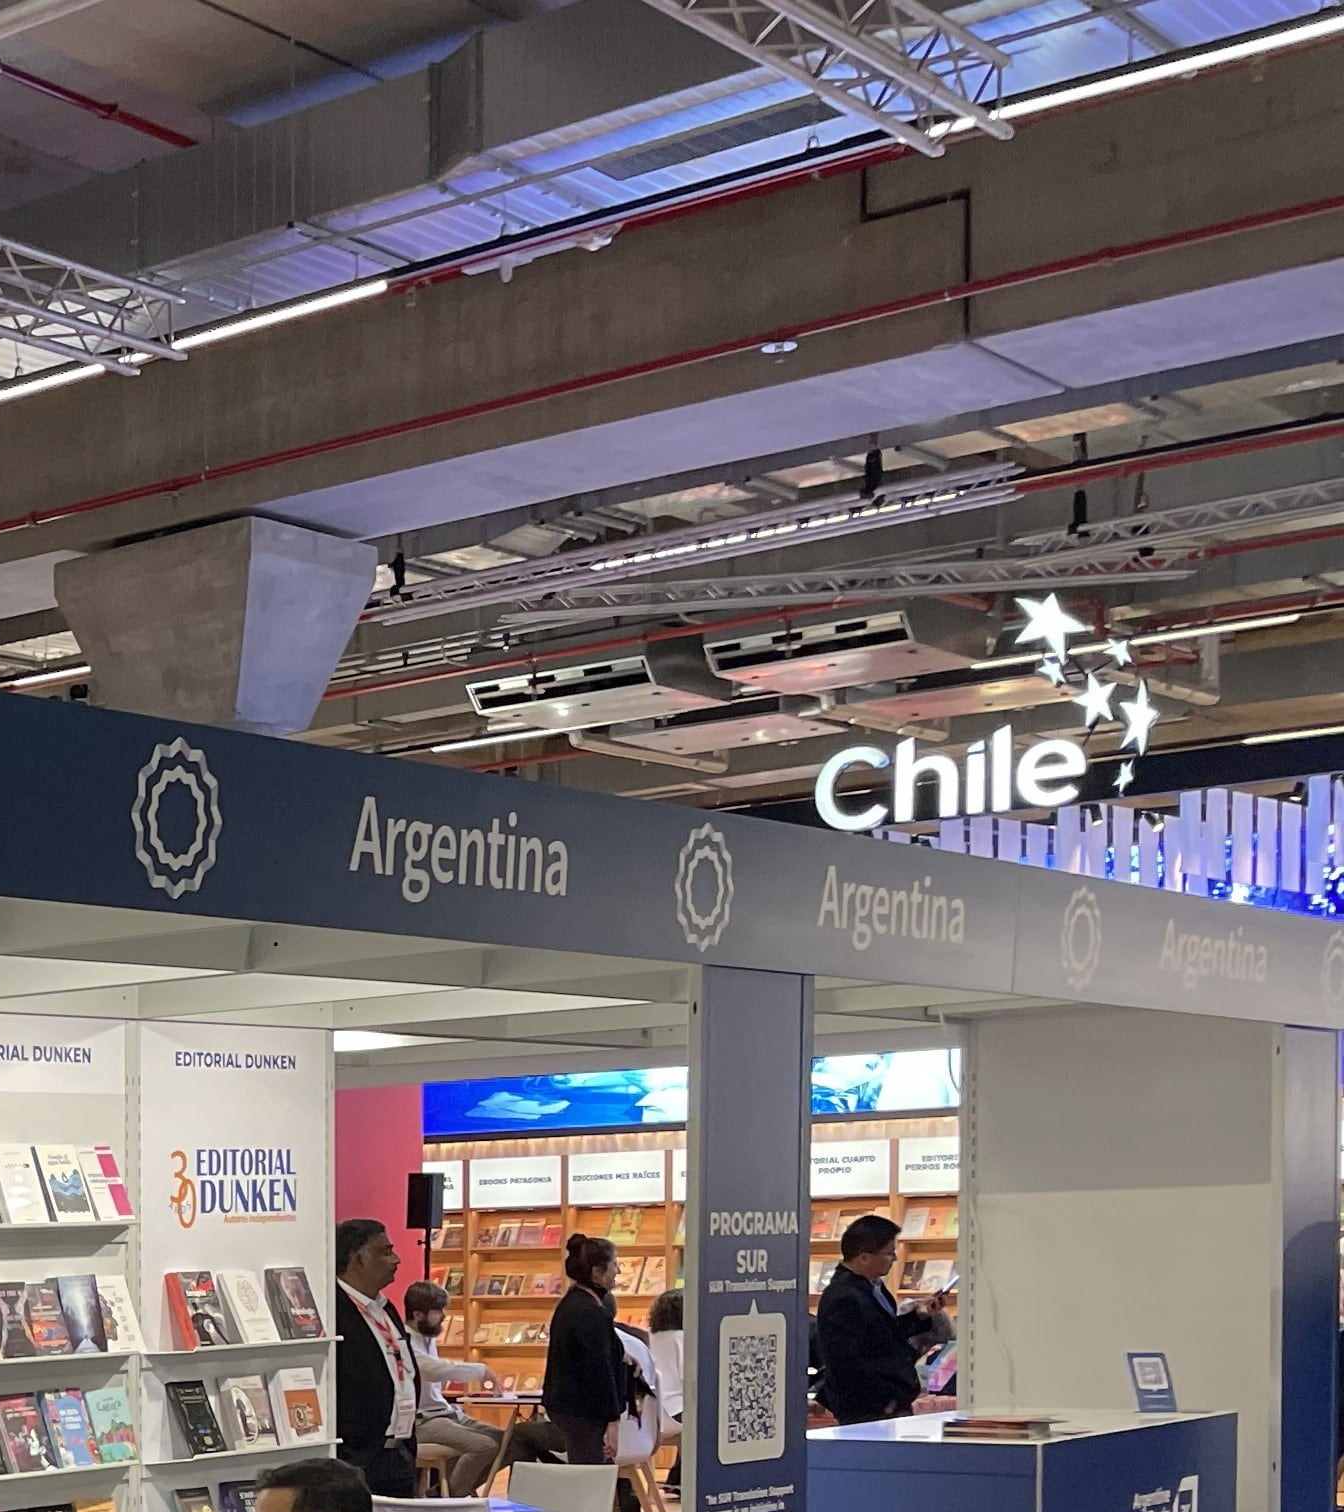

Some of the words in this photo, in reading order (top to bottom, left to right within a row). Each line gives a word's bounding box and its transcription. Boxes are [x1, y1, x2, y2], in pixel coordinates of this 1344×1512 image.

[814, 724, 1087, 832] Chile
[349, 796, 568, 903] Argentina
[818, 865, 965, 951] Argentina
[1159, 919, 1267, 989] Argentina
[32, 1046, 92, 1063] DUNKEN
[175, 1051, 242, 1068] EDITORIAL
[245, 1054, 296, 1069] DUNKEN
[196, 1149, 296, 1176] EDITORIAL
[200, 1179, 297, 1213] DUNKEN
[709, 1211, 799, 1236] PROGRAMA
[736, 1249, 769, 1274] SUR
